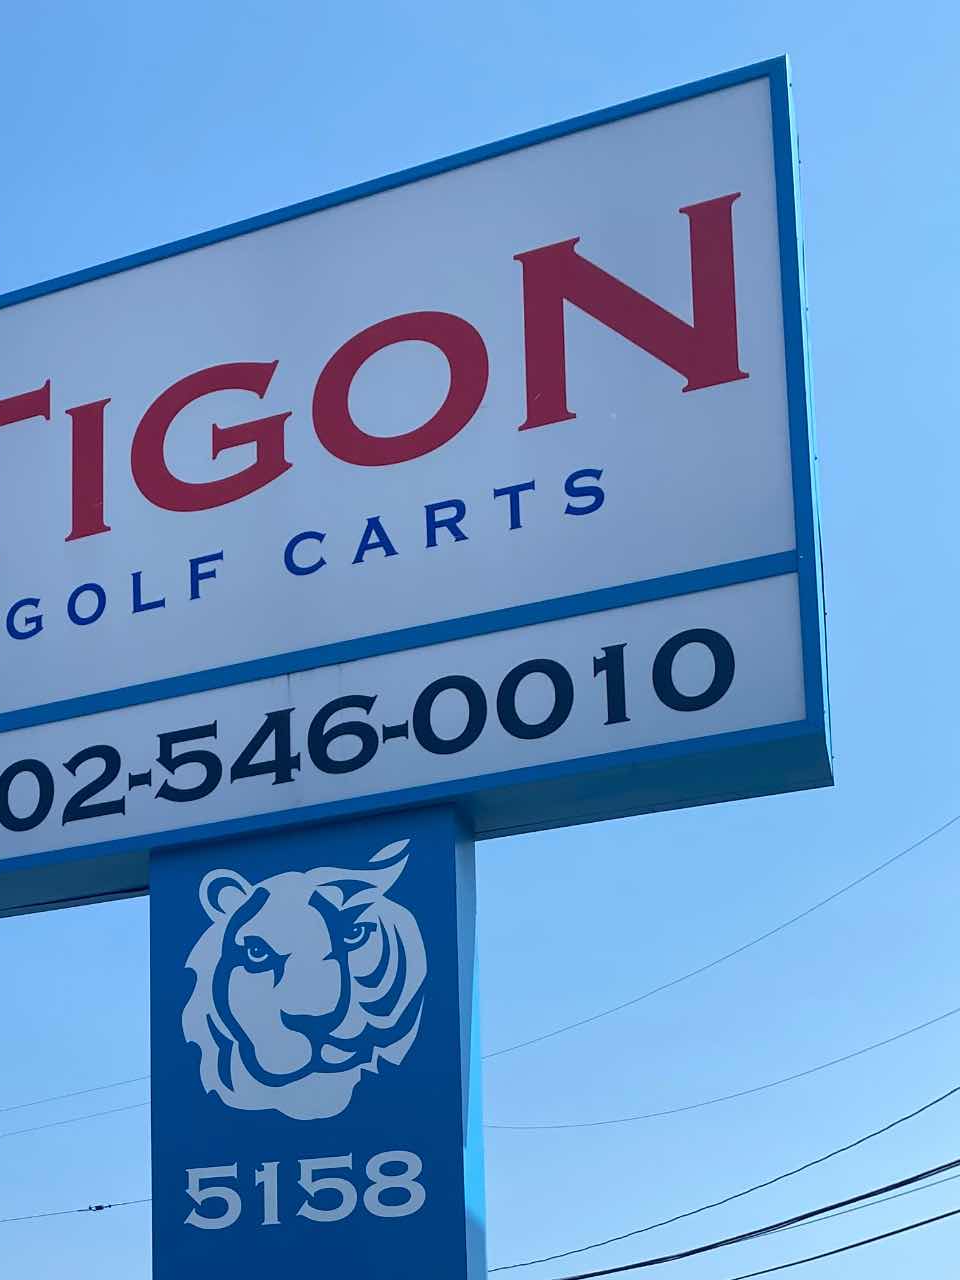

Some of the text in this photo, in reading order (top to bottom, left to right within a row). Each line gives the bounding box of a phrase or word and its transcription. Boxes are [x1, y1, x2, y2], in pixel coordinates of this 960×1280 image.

[6, 468, 606, 640] GOLF CARTS
[184, 1150, 426, 1230] 5158
